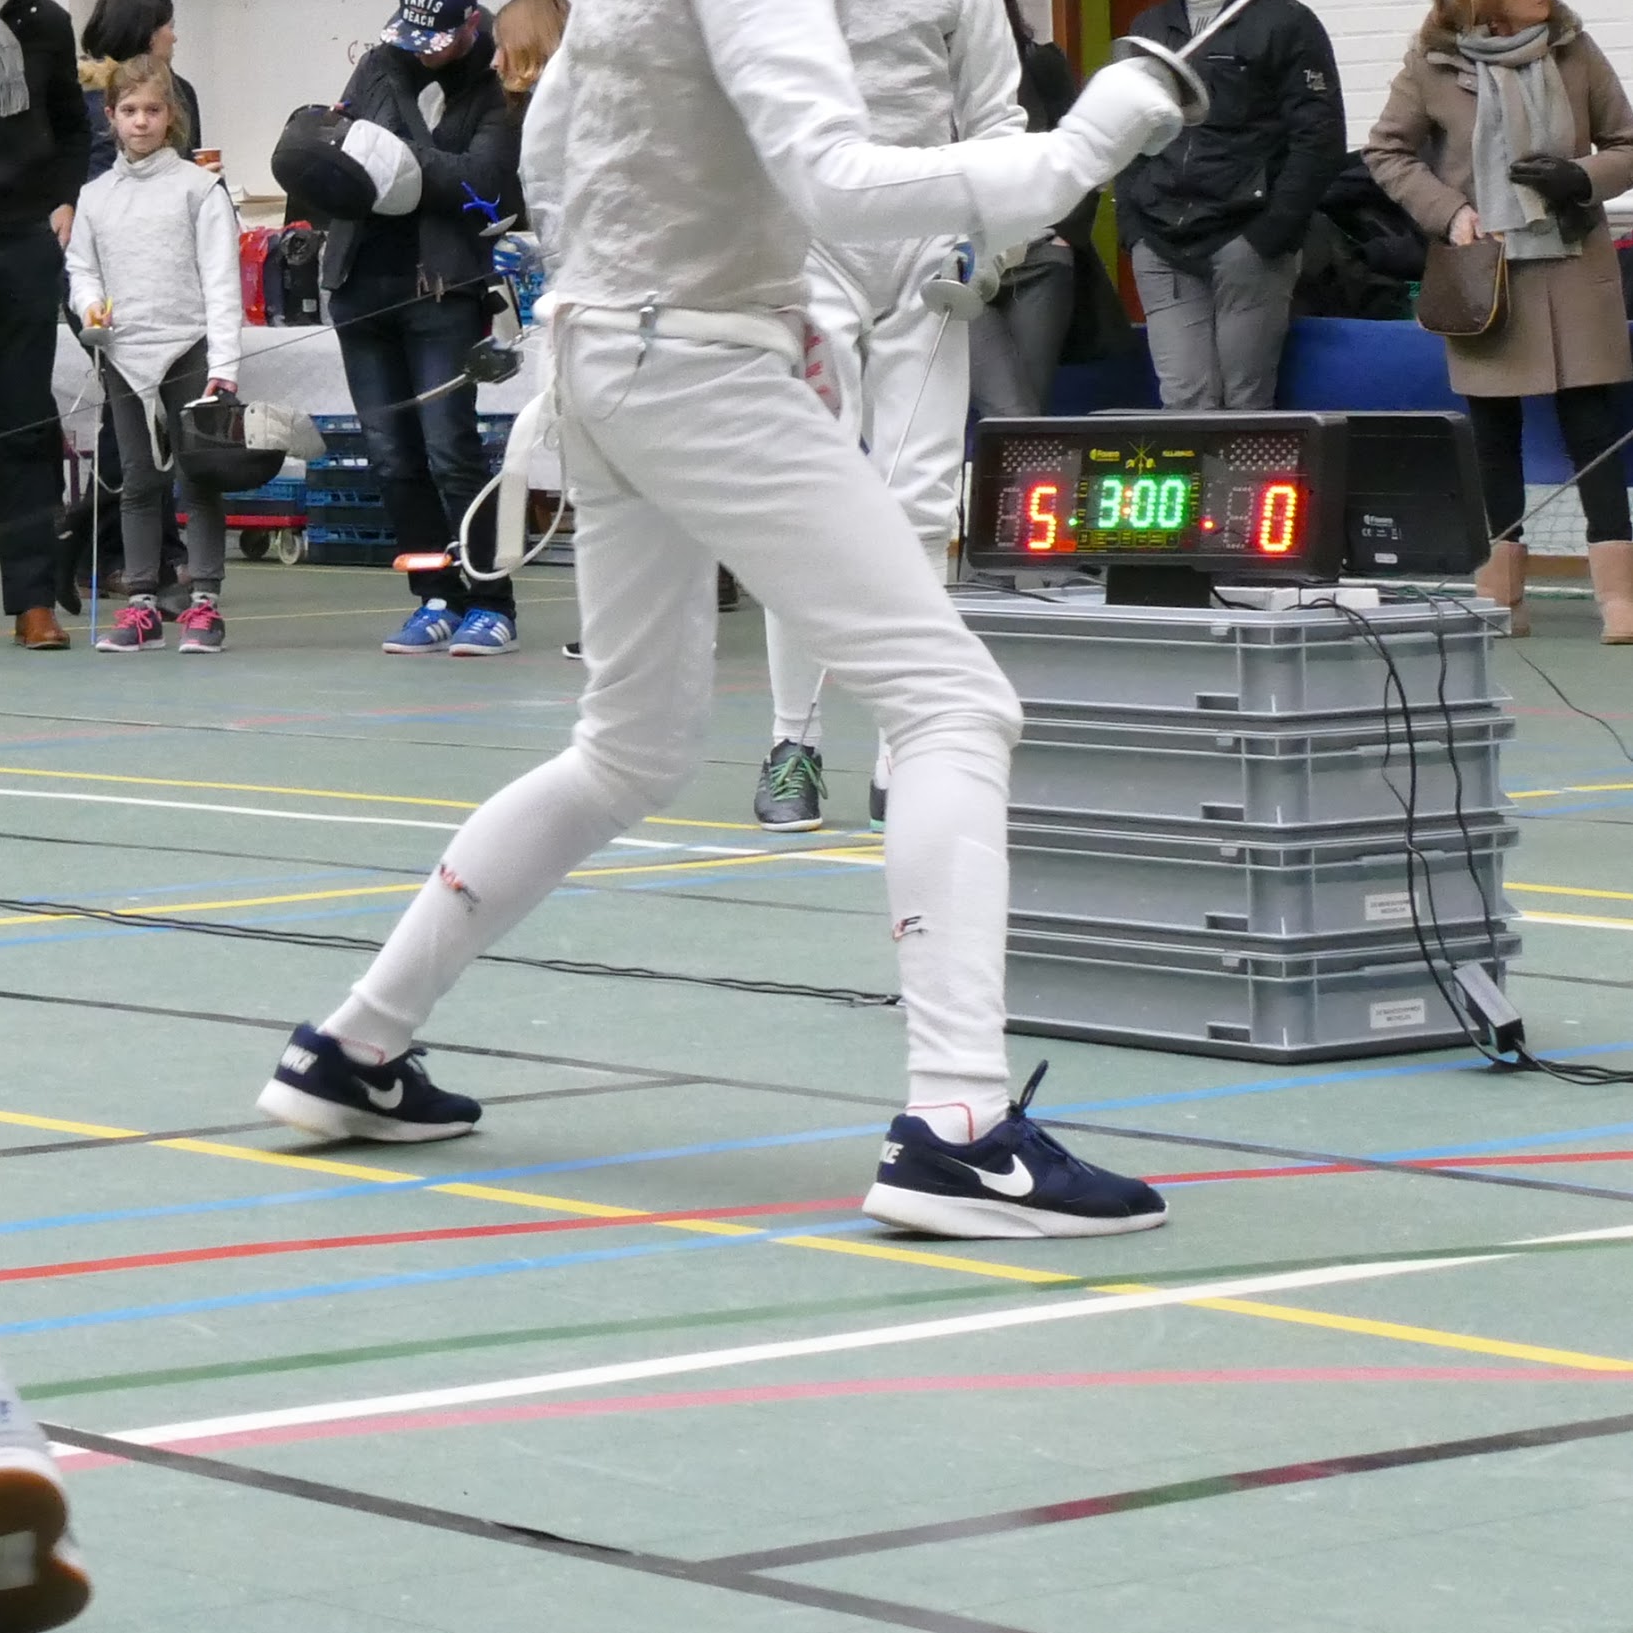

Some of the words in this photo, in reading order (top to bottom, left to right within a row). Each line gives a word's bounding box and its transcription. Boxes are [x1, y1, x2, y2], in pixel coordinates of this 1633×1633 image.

[402, 8, 435, 27] BEACH
[1027, 485, 1058, 550] 5
[1097, 478, 1186, 528] 3:00
[1259, 484, 1298, 552] 0
